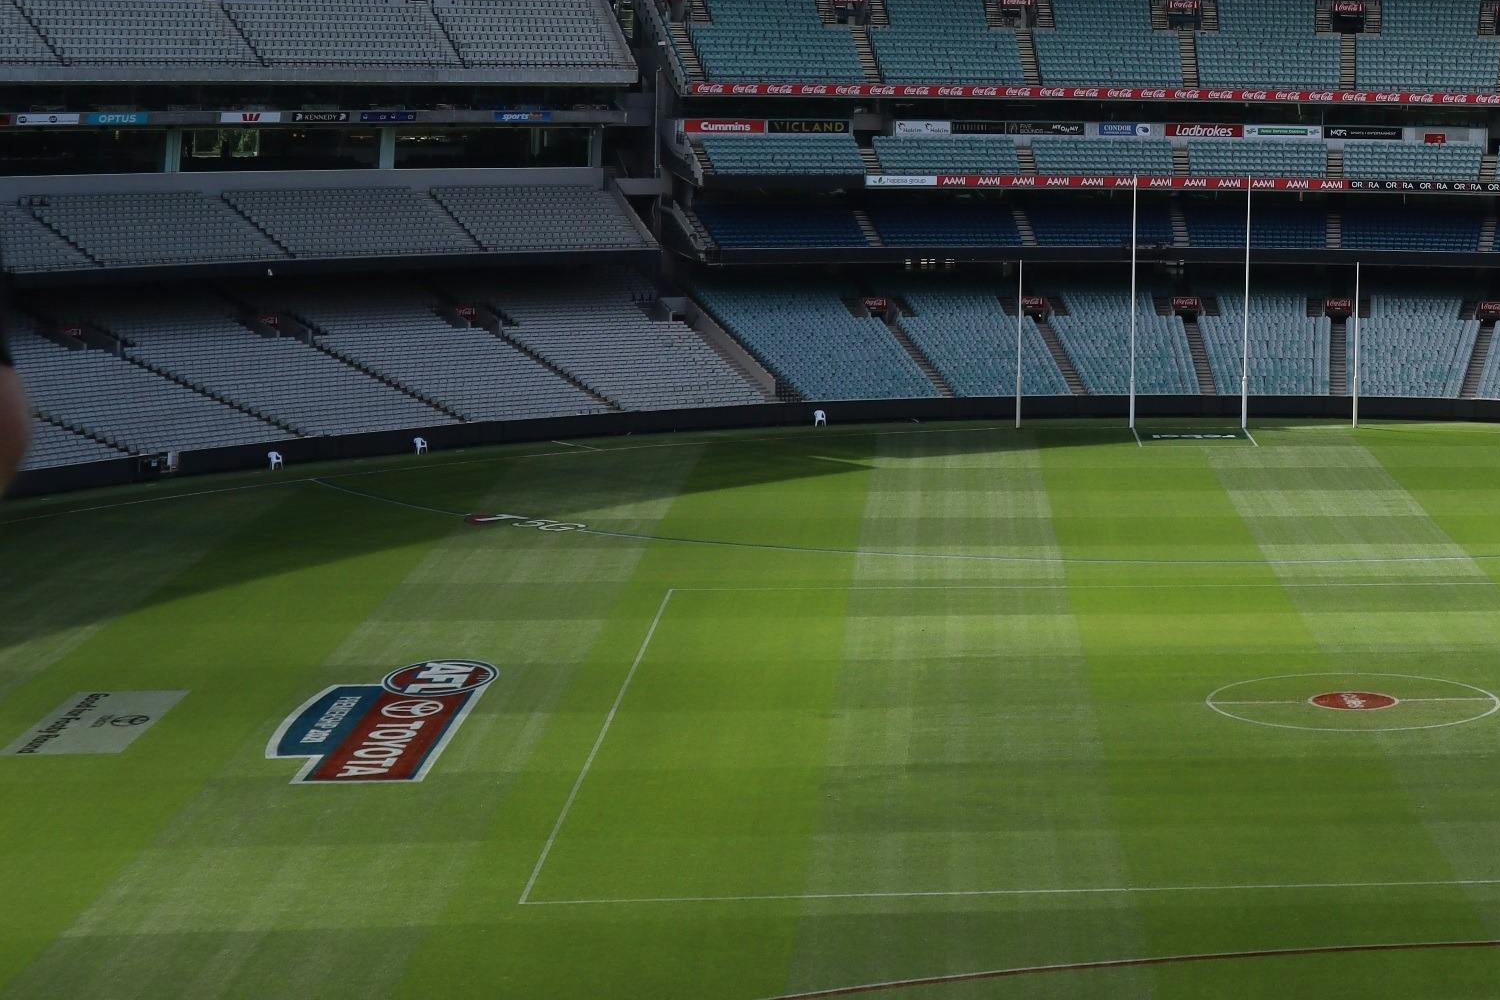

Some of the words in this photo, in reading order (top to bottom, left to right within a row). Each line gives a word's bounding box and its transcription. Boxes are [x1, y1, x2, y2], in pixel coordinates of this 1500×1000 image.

[700, 121, 751, 131] Cummins
[774, 122, 845, 132] VICLAND
[1176, 124, 1233, 137] Ladbrokes
[943, 176, 966, 185] AAMI
[977, 176, 1000, 185] AAMI
[1011, 177, 1034, 185] AAMI
[1046, 177, 1069, 185] AAMI
[1080, 177, 1104, 186] AAMI
[1150, 178, 1172, 186] AAMI
[1184, 179, 1206, 187] AAMI
[1217, 179, 1241, 187] AAMI
[1252, 180, 1275, 188] AAMI
[1286, 180, 1309, 188] AAMI
[1320, 181, 1343, 189] AAMI
[403, 662, 475, 694] AFL
[335, 720, 425, 778] TOYOTA
